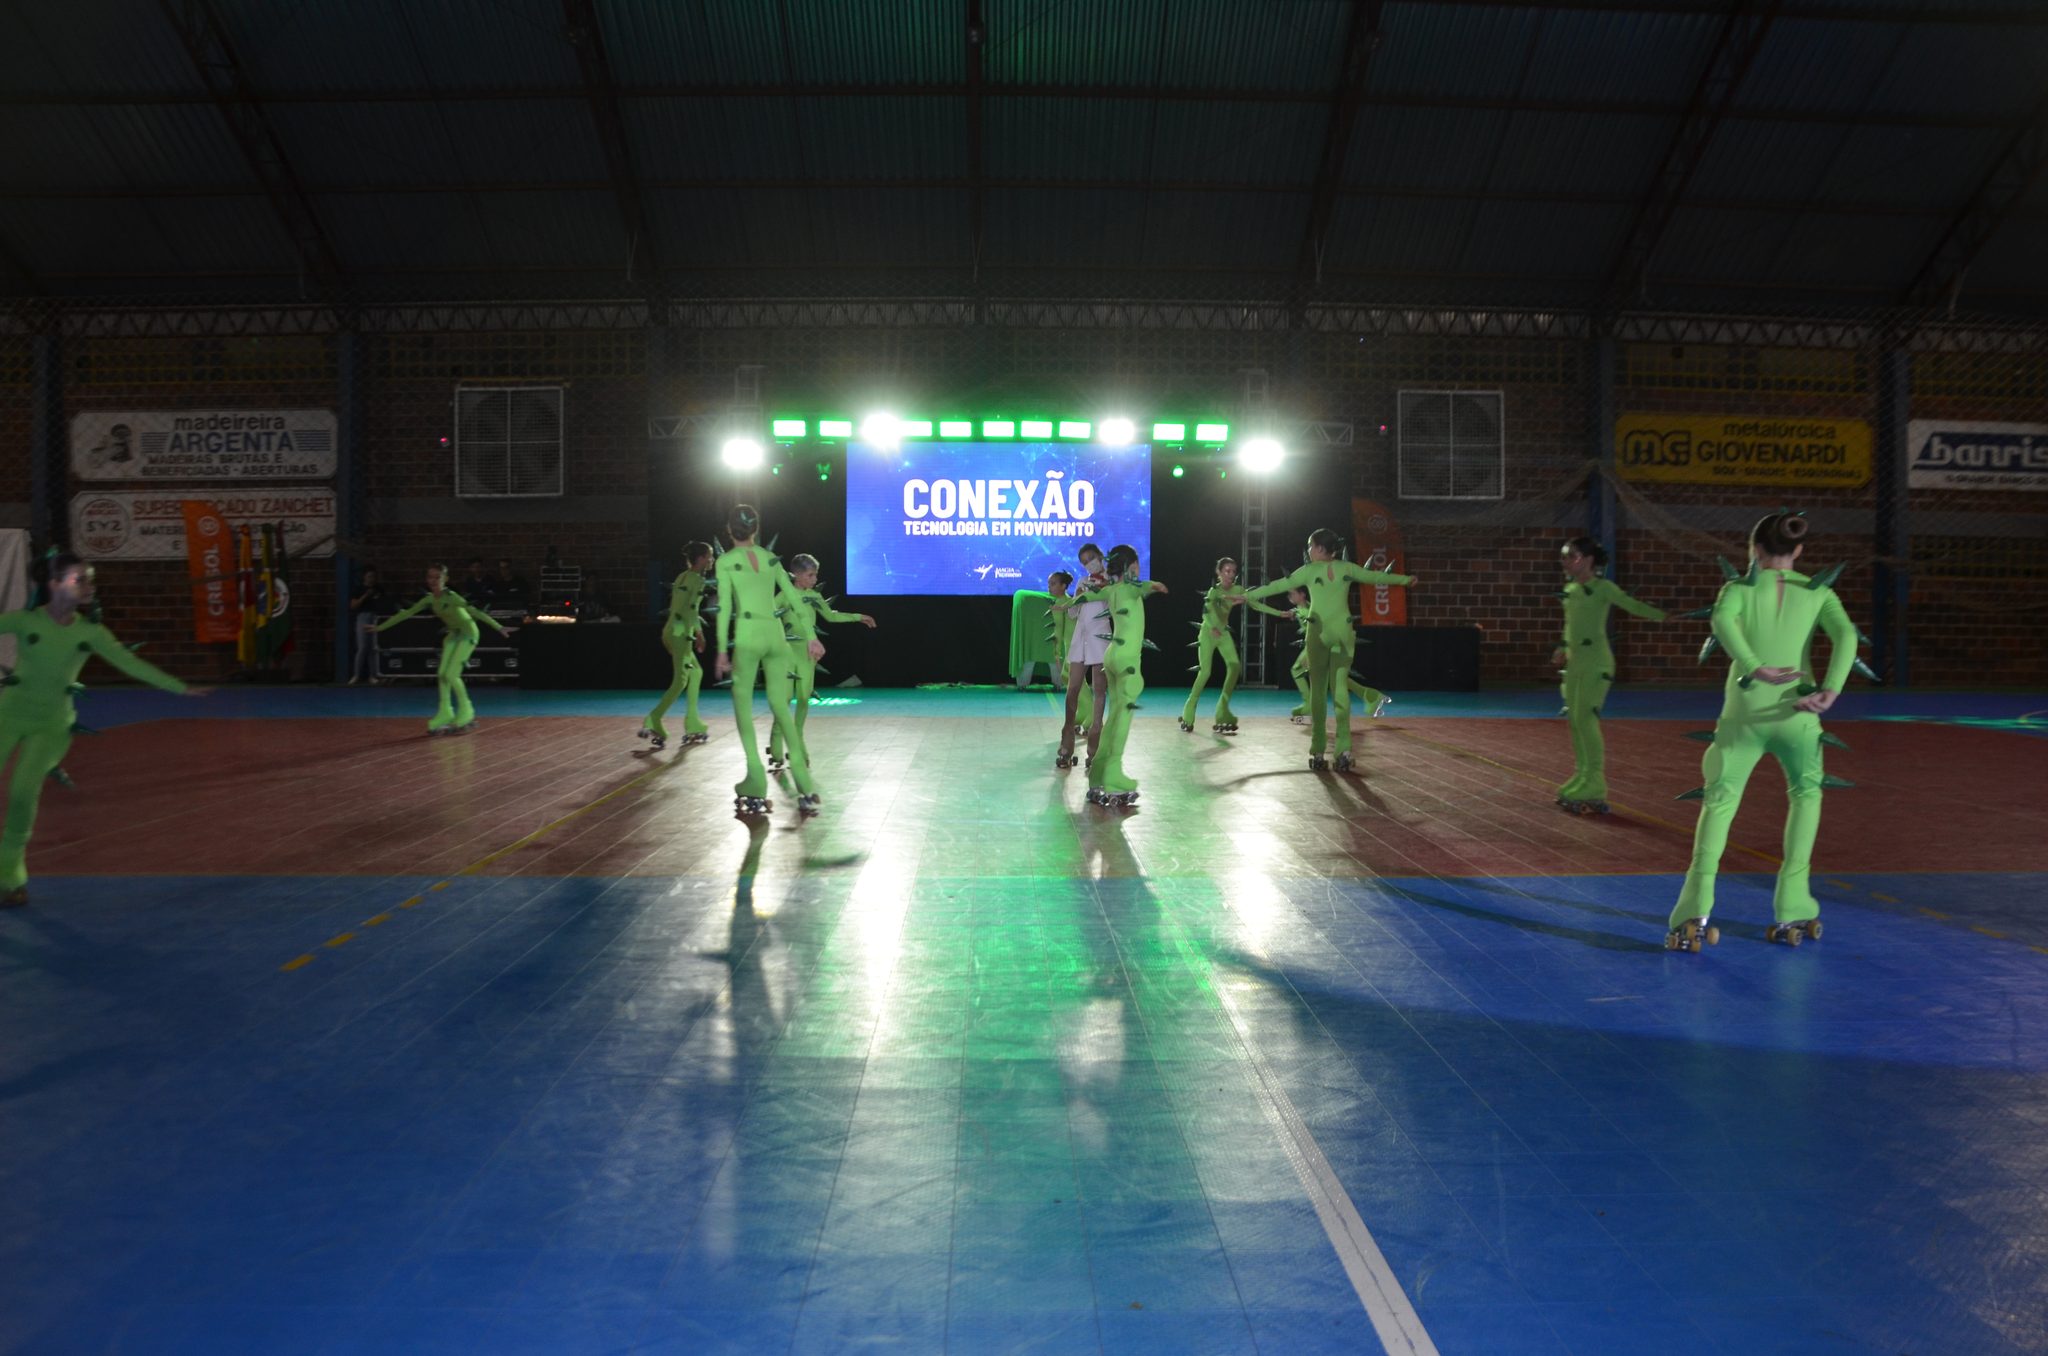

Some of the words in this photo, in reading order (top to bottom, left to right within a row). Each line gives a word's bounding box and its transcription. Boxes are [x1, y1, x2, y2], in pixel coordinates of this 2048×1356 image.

[174, 414, 286, 431] madeireira
[169, 432, 294, 453] ARGENTA
[1696, 440, 1846, 464] GIOVENARDI
[148, 453, 213, 464] MADEIRAS
[220, 453, 269, 464] BRUTAS
[274, 453, 282, 463] E
[142, 465, 230, 476] BENEFICIADAS
[241, 464, 318, 475] ABERTURAS
[903, 470, 1095, 519] CONEXÃO
[260, 497, 333, 513] ZANCHET
[903, 520, 988, 536] TECNOLOGIA
[992, 521, 1011, 536] EM
[1014, 521, 1095, 537] MOVIMENTO
[204, 543, 225, 616] CRESOL
[1373, 545, 1390, 616] CREOL
